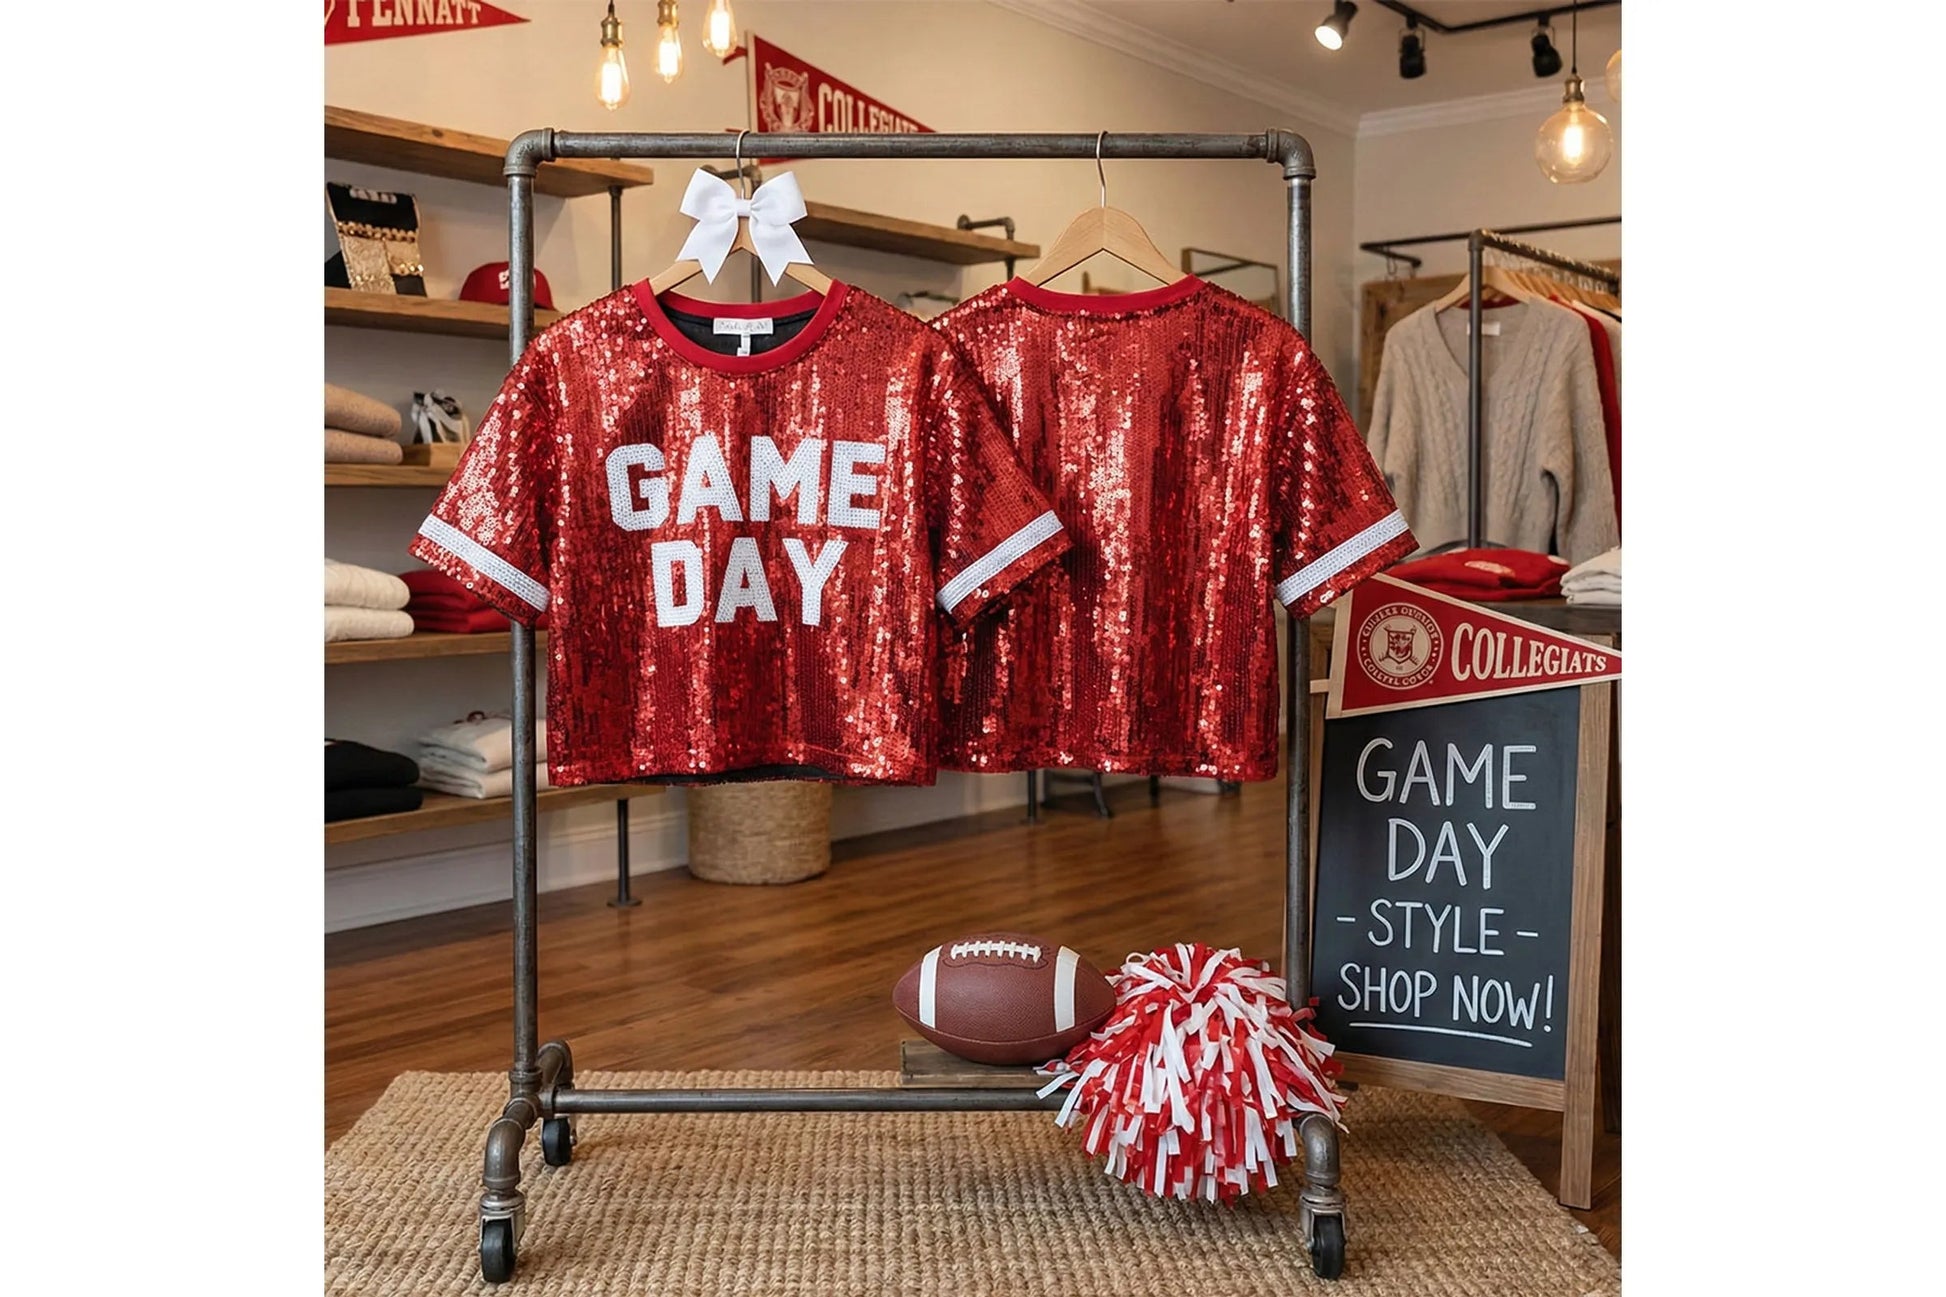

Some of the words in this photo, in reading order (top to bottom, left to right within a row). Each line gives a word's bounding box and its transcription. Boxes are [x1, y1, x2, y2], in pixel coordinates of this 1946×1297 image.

[605, 430, 886, 532] GAME
[650, 537, 849, 628] DAY
[1451, 622, 1607, 681] COLLEGIATS
[1356, 737, 1536, 810] GAME
[1388, 818, 1509, 890] DAY
[1368, 898, 1504, 956] STYLE
[1337, 962, 1438, 1018] SHOP
[1453, 974, 1554, 1033] NOW!
